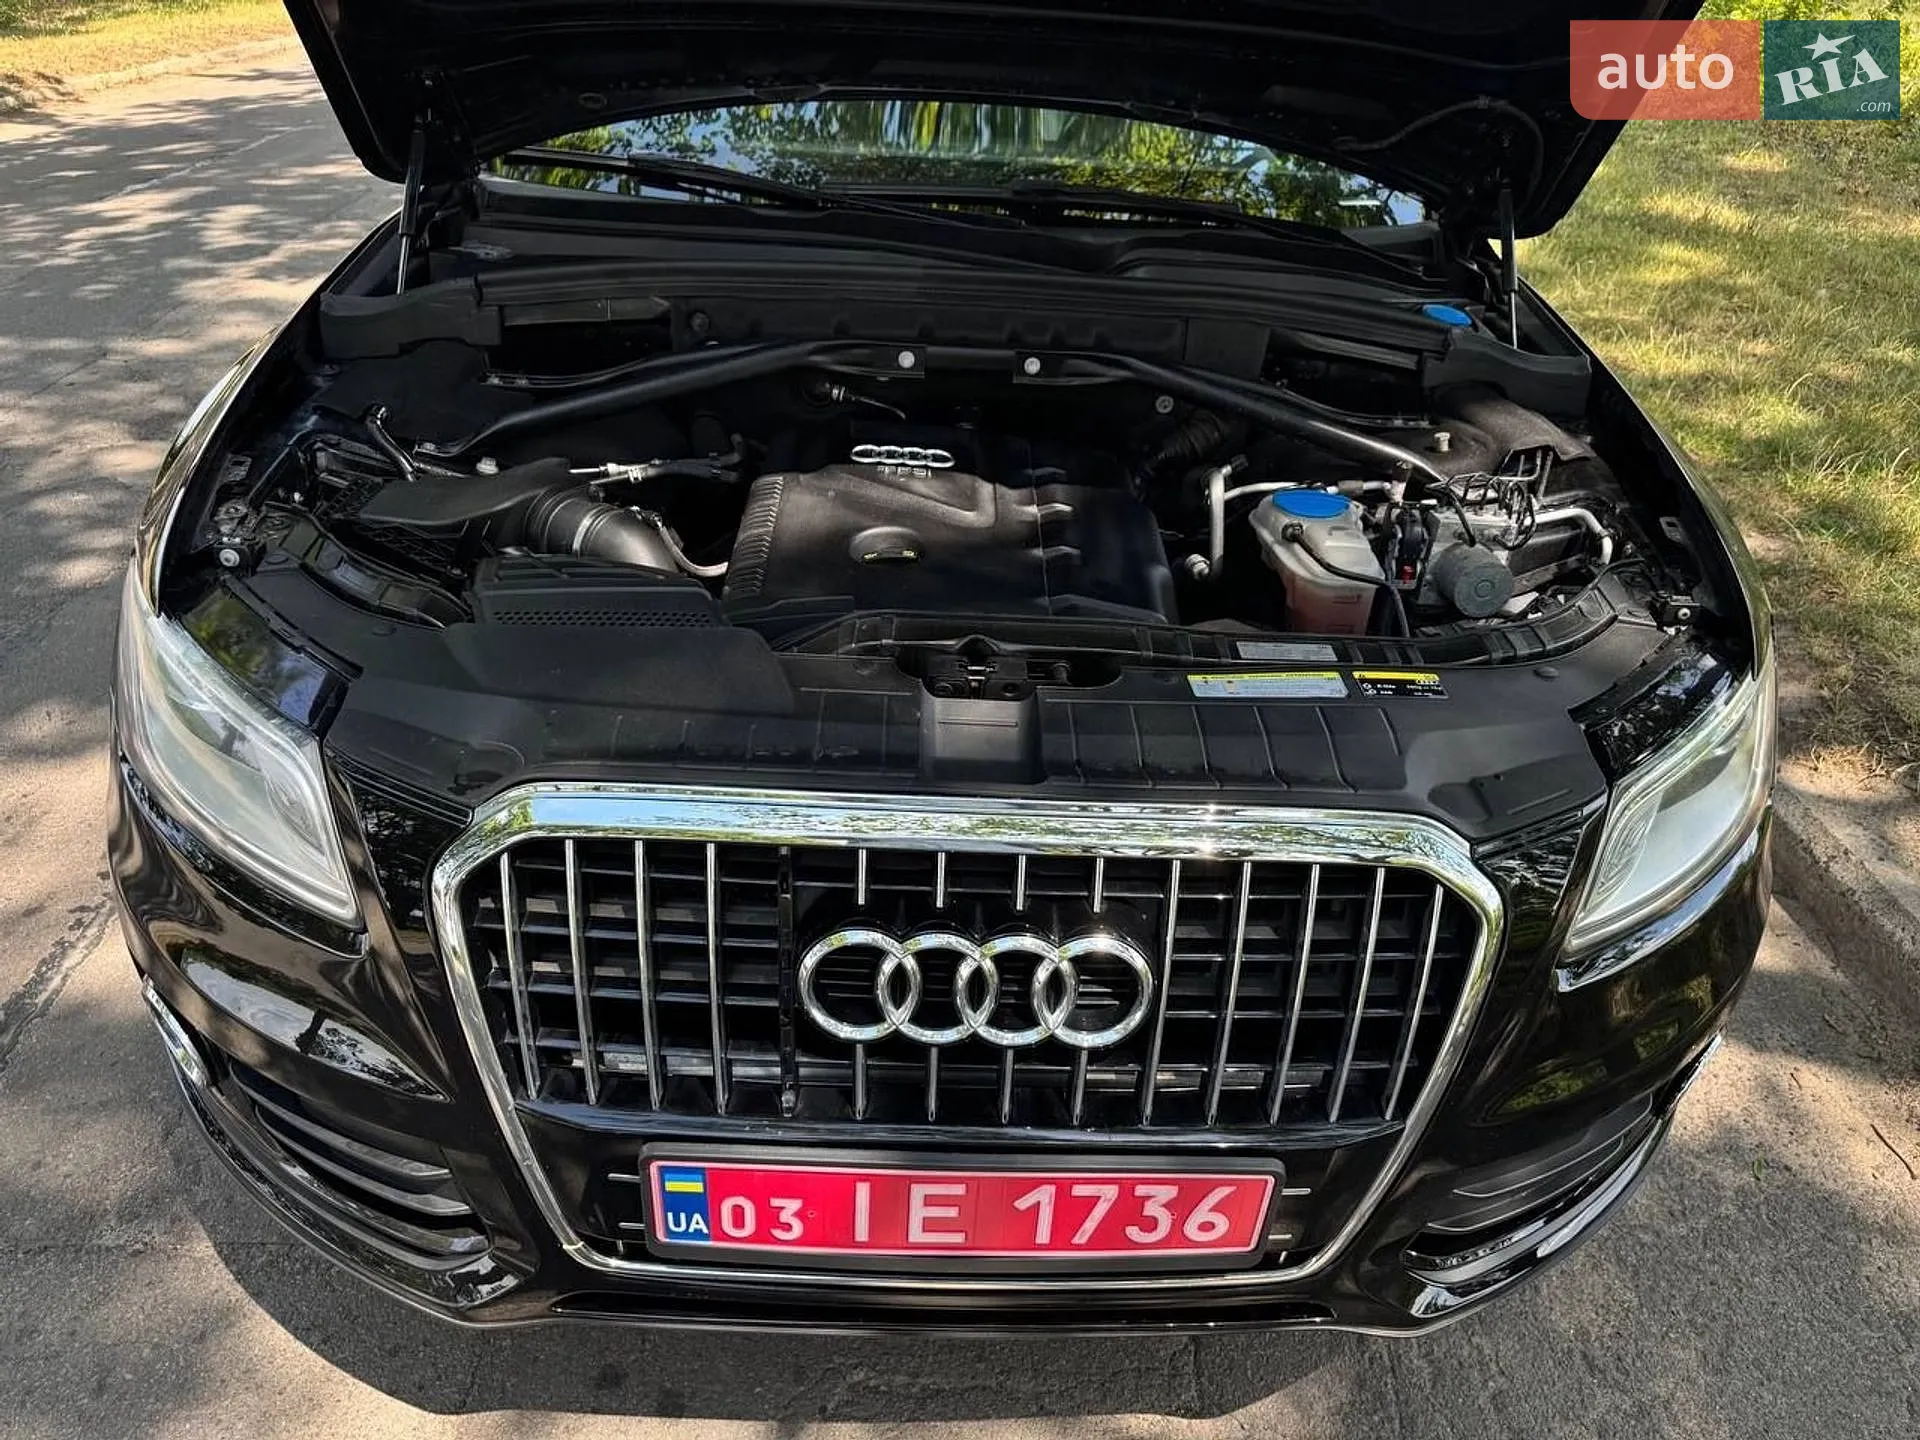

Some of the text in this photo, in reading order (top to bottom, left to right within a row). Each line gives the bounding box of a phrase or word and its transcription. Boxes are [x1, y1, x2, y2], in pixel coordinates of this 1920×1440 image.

[667, 1212, 709, 1234] UA
[720, 1181, 1237, 1244] 03 IE 1736
